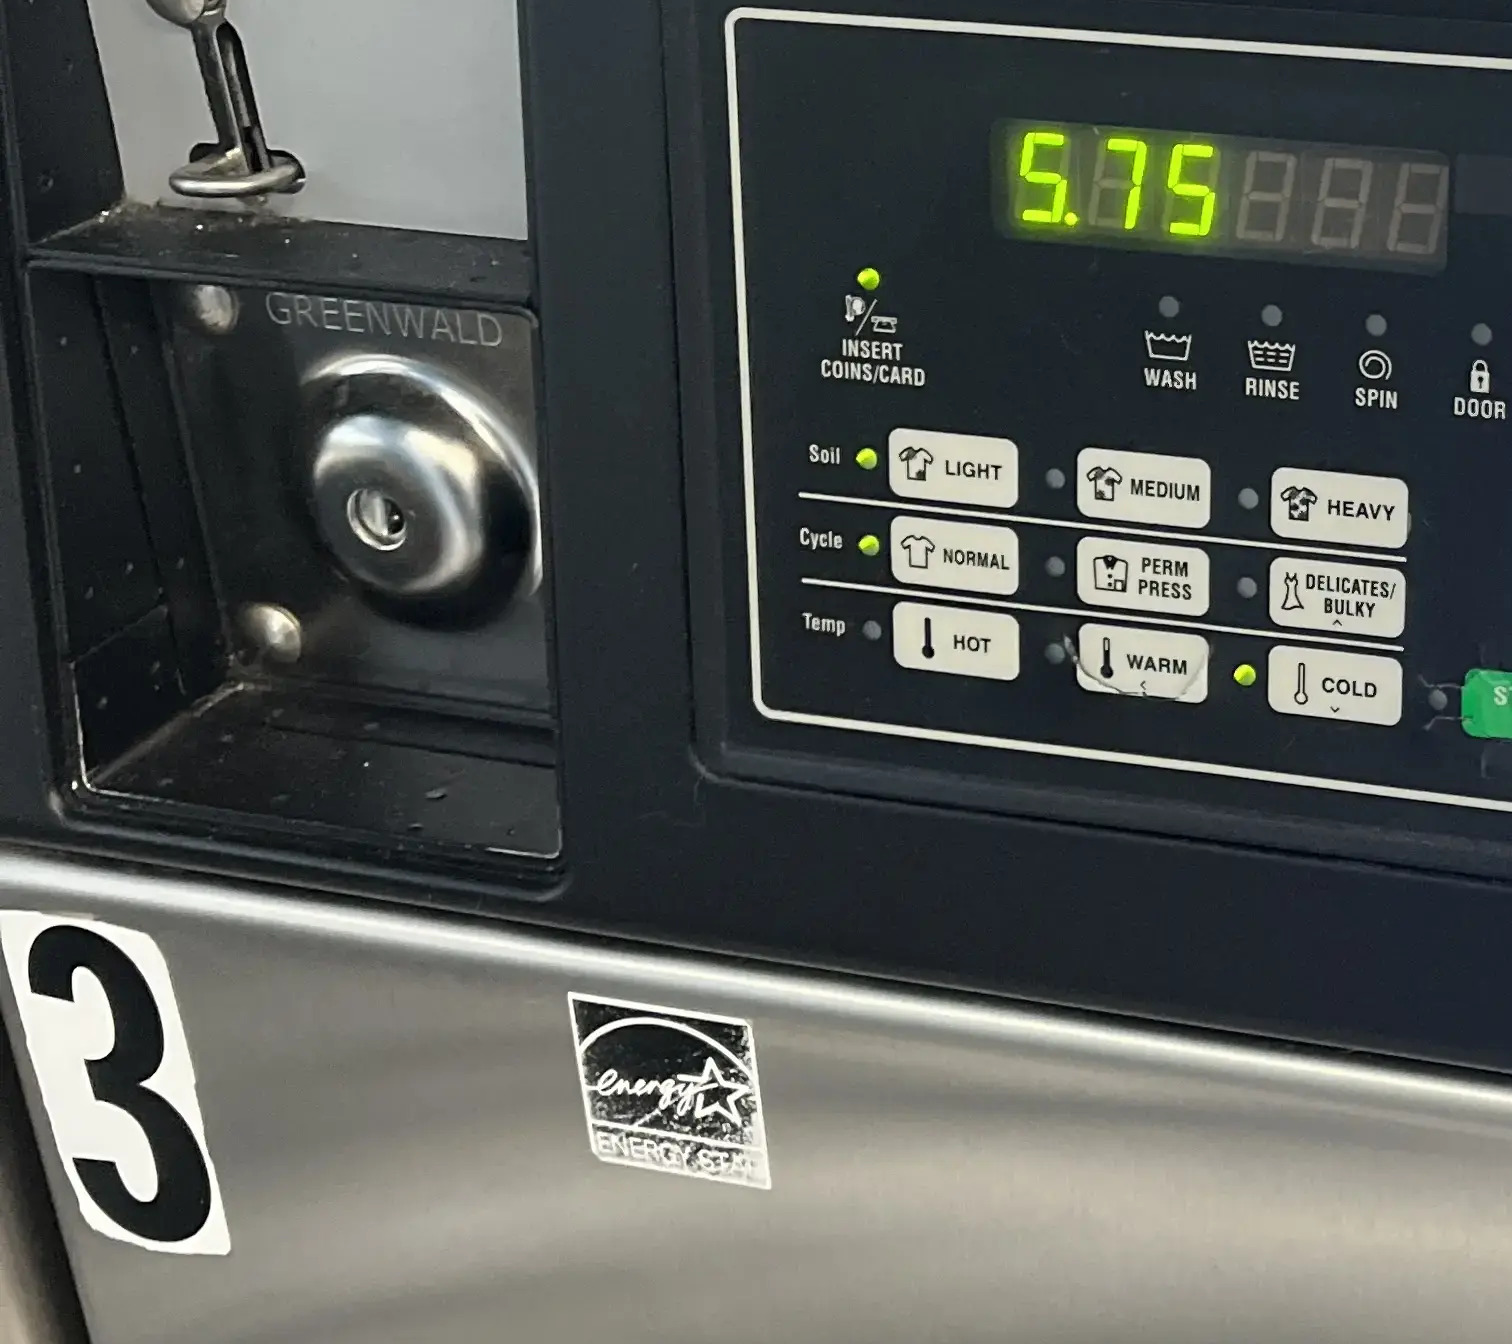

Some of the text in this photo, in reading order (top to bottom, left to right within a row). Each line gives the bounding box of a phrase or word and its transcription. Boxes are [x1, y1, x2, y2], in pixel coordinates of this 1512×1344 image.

[1019, 132, 1215, 237] 5.75
[265, 292, 503, 348] GREENWALD
[842, 339, 903, 361] INSERT
[821, 360, 926, 387] COINS/CARD
[1144, 368, 1196, 390] WASH
[1245, 377, 1299, 400] RINSE
[1355, 388, 1398, 409] SPIN
[1454, 397, 1506, 419] DOOR
[809, 443, 841, 466] Soil
[945, 460, 1002, 482] LIGHT
[1129, 477, 1201, 503] MEDIUM
[1326, 498, 1396, 522] HEAVY
[799, 528, 843, 555] Cycle
[943, 547, 1010, 571] NORMAL
[1141, 557, 1189, 579] PERM
[1138, 578, 1193, 602] PRESS
[1305, 573, 1396, 600] DELICATES/
[1323, 597, 1377, 620] BULKY
[802, 612, 847, 639] Temp
[953, 634, 992, 654] HOT
[1126, 653, 1188, 677] WARM
[1322, 677, 1378, 699] COLD
[28, 924, 211, 1244] 3
